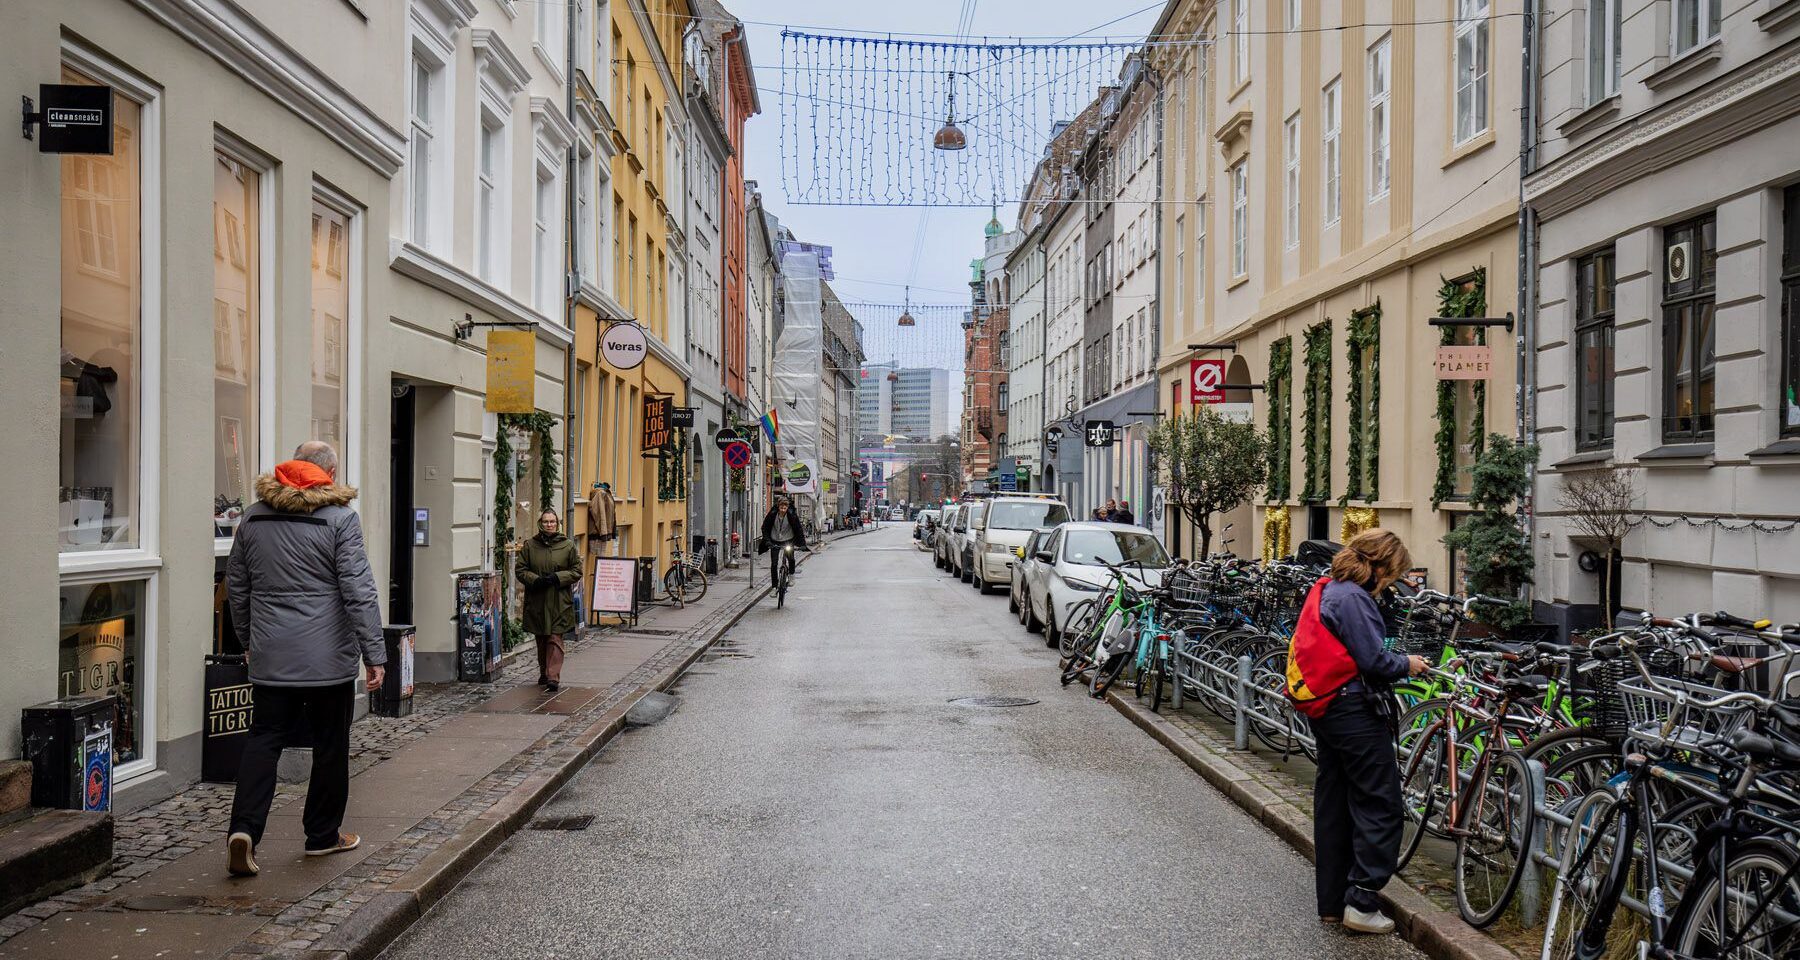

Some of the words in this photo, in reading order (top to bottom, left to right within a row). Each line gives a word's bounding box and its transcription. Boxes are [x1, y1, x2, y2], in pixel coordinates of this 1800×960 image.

[608, 341, 642, 351] Veras
[1439, 362, 1490, 371] PLANET
[646, 400, 665, 417] THE
[645, 416, 664, 433] LOG
[644, 430, 670, 448] LADY
